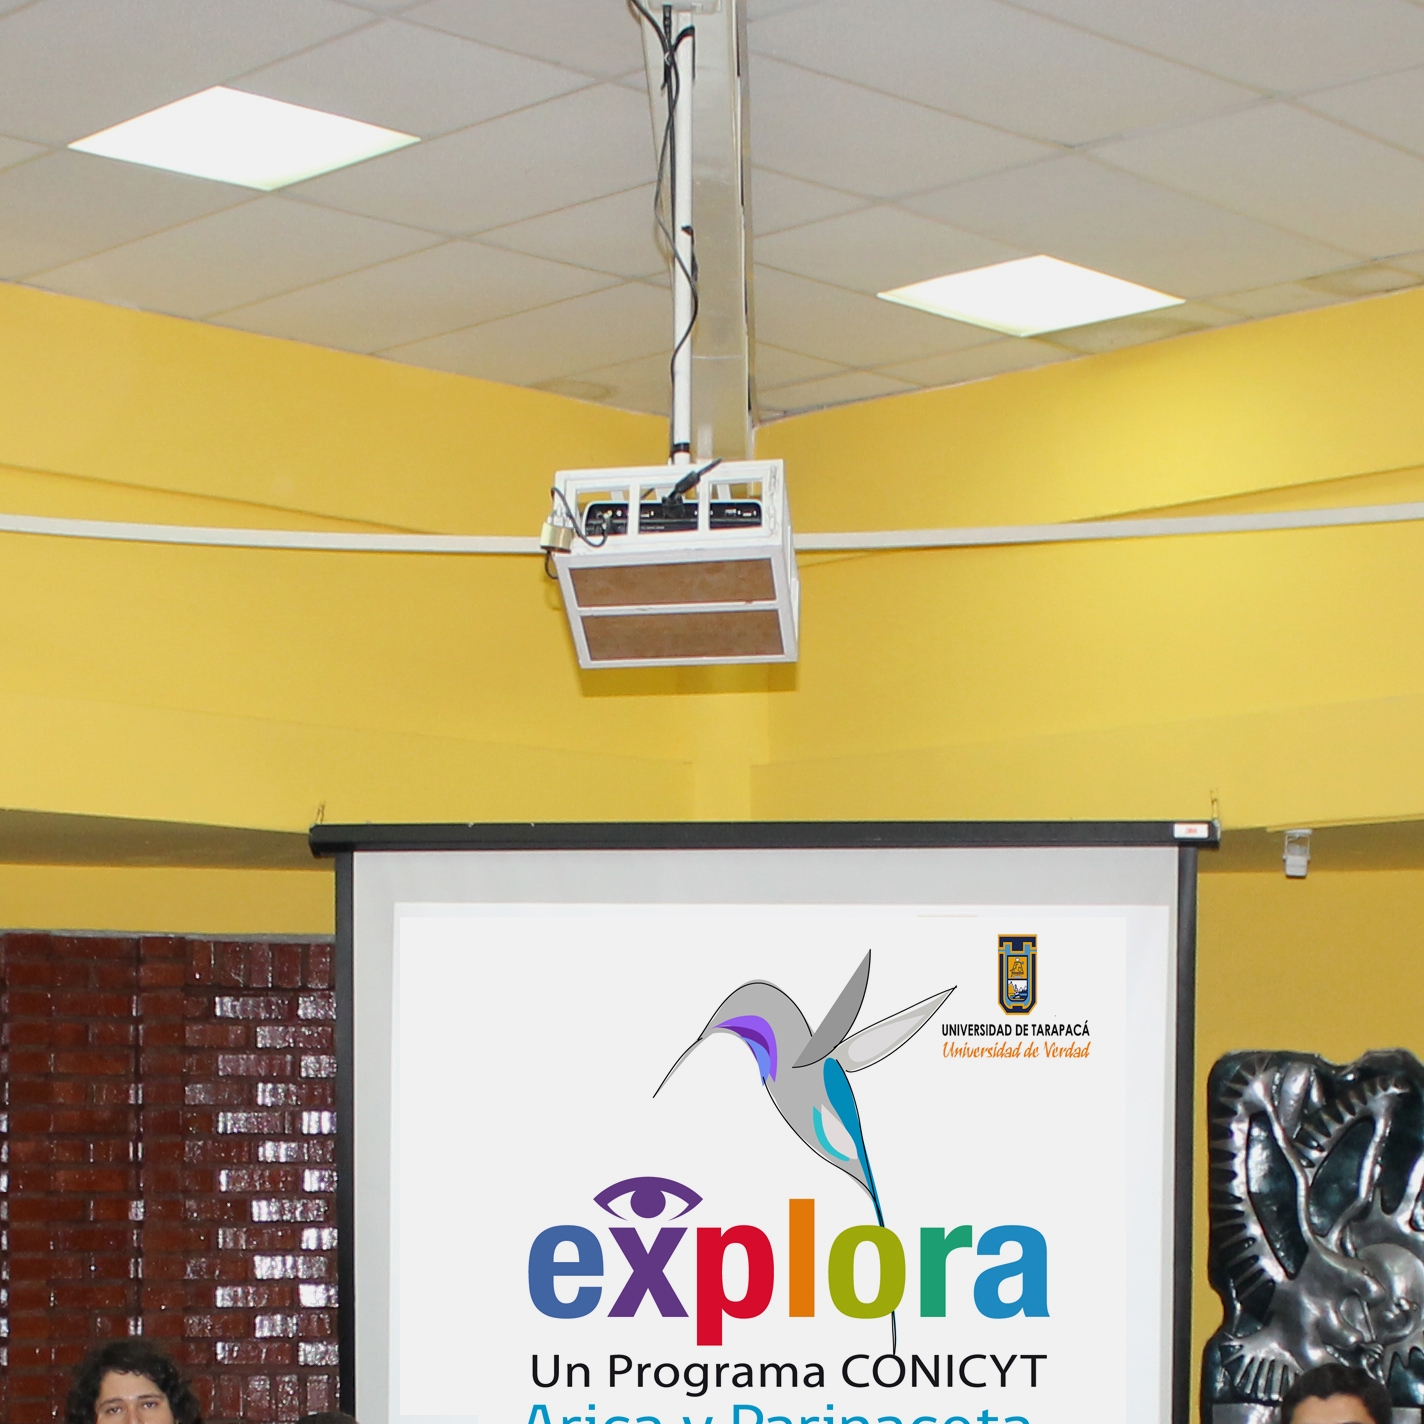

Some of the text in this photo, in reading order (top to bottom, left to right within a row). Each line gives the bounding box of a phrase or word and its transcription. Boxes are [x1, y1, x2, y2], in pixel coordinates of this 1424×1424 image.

[941, 1019, 1091, 1037] UNIVERSIDAD DE TARAPACÁ
[942, 1041, 1092, 1059] Universidad de Verdad
[527, 1197, 1051, 1347] explora
[532, 1353, 1048, 1398] Un Programa CONICYT
